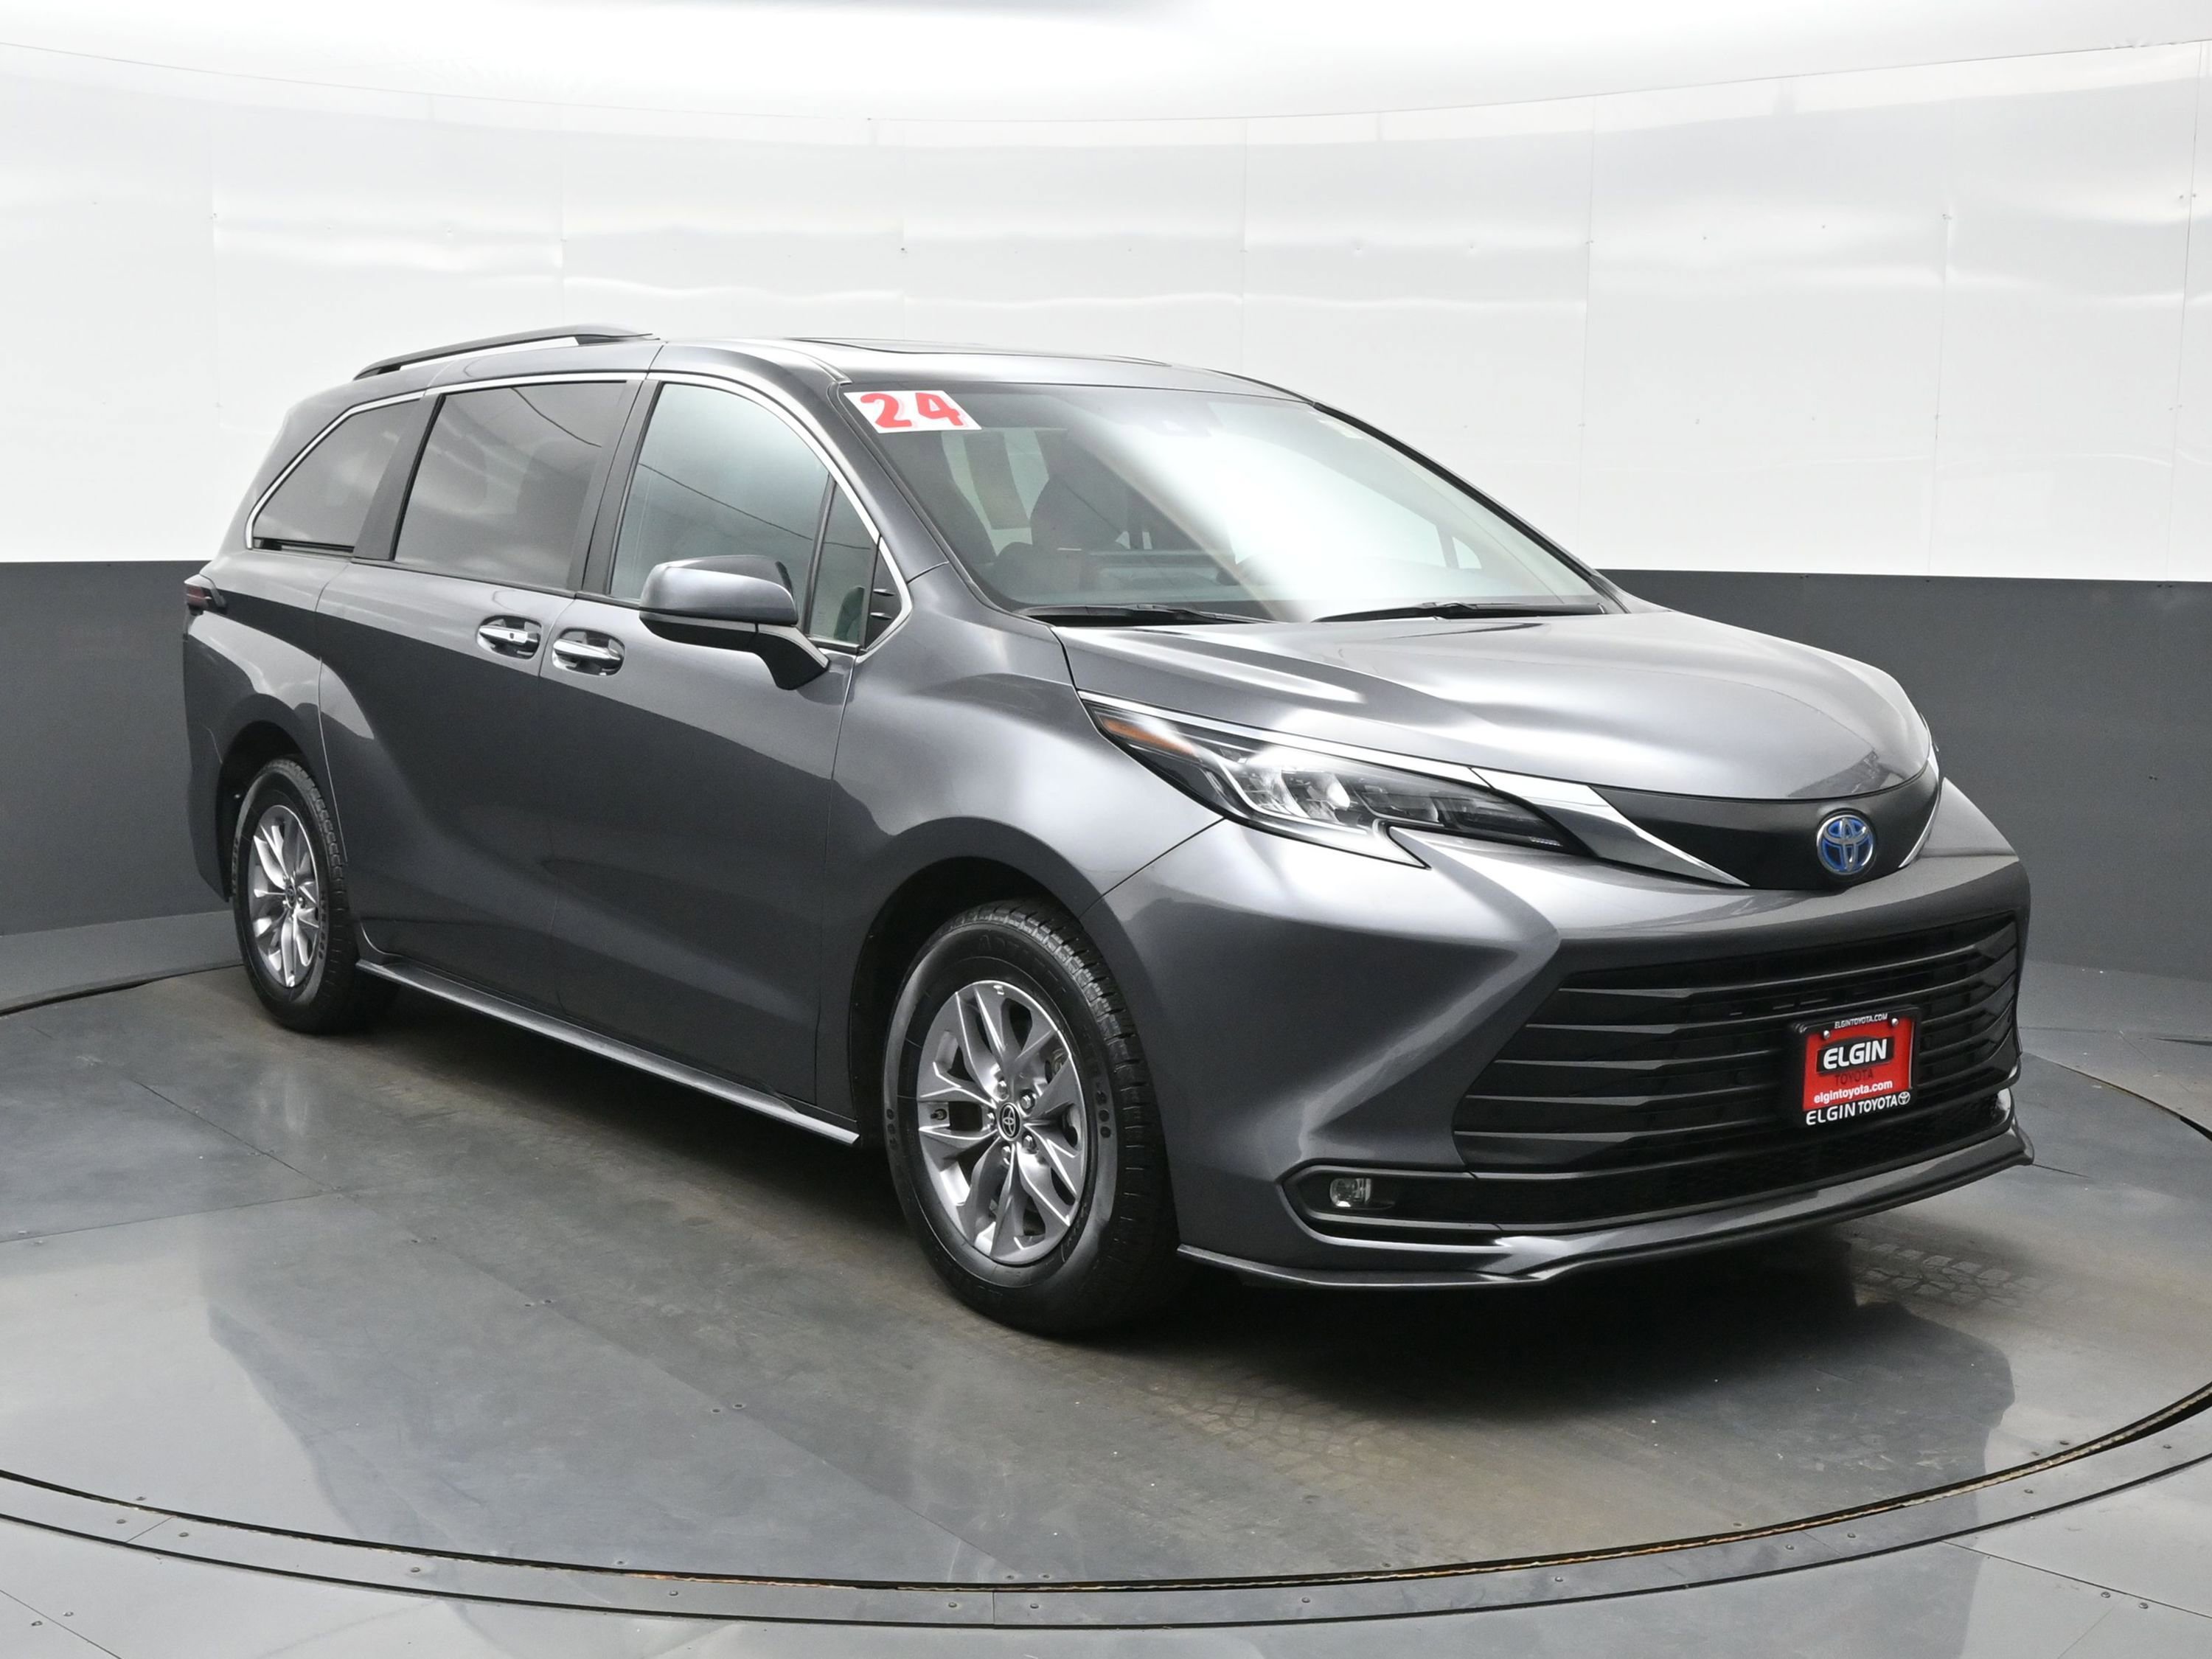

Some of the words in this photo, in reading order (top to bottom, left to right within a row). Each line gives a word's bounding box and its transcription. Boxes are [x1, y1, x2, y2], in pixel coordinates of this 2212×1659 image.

[860, 392, 966, 428] 24
[1834, 1012, 1888, 1029] ELGINTOYOTA.COM
[1823, 1038, 1888, 1070] ELGIN
[1834, 1068, 1874, 1086] TOYOTA
[1813, 1079, 1893, 1105] elgintoyota.com
[1806, 1101, 1856, 1126] ELGIN
[1857, 1094, 1898, 1114] TOYOTA
